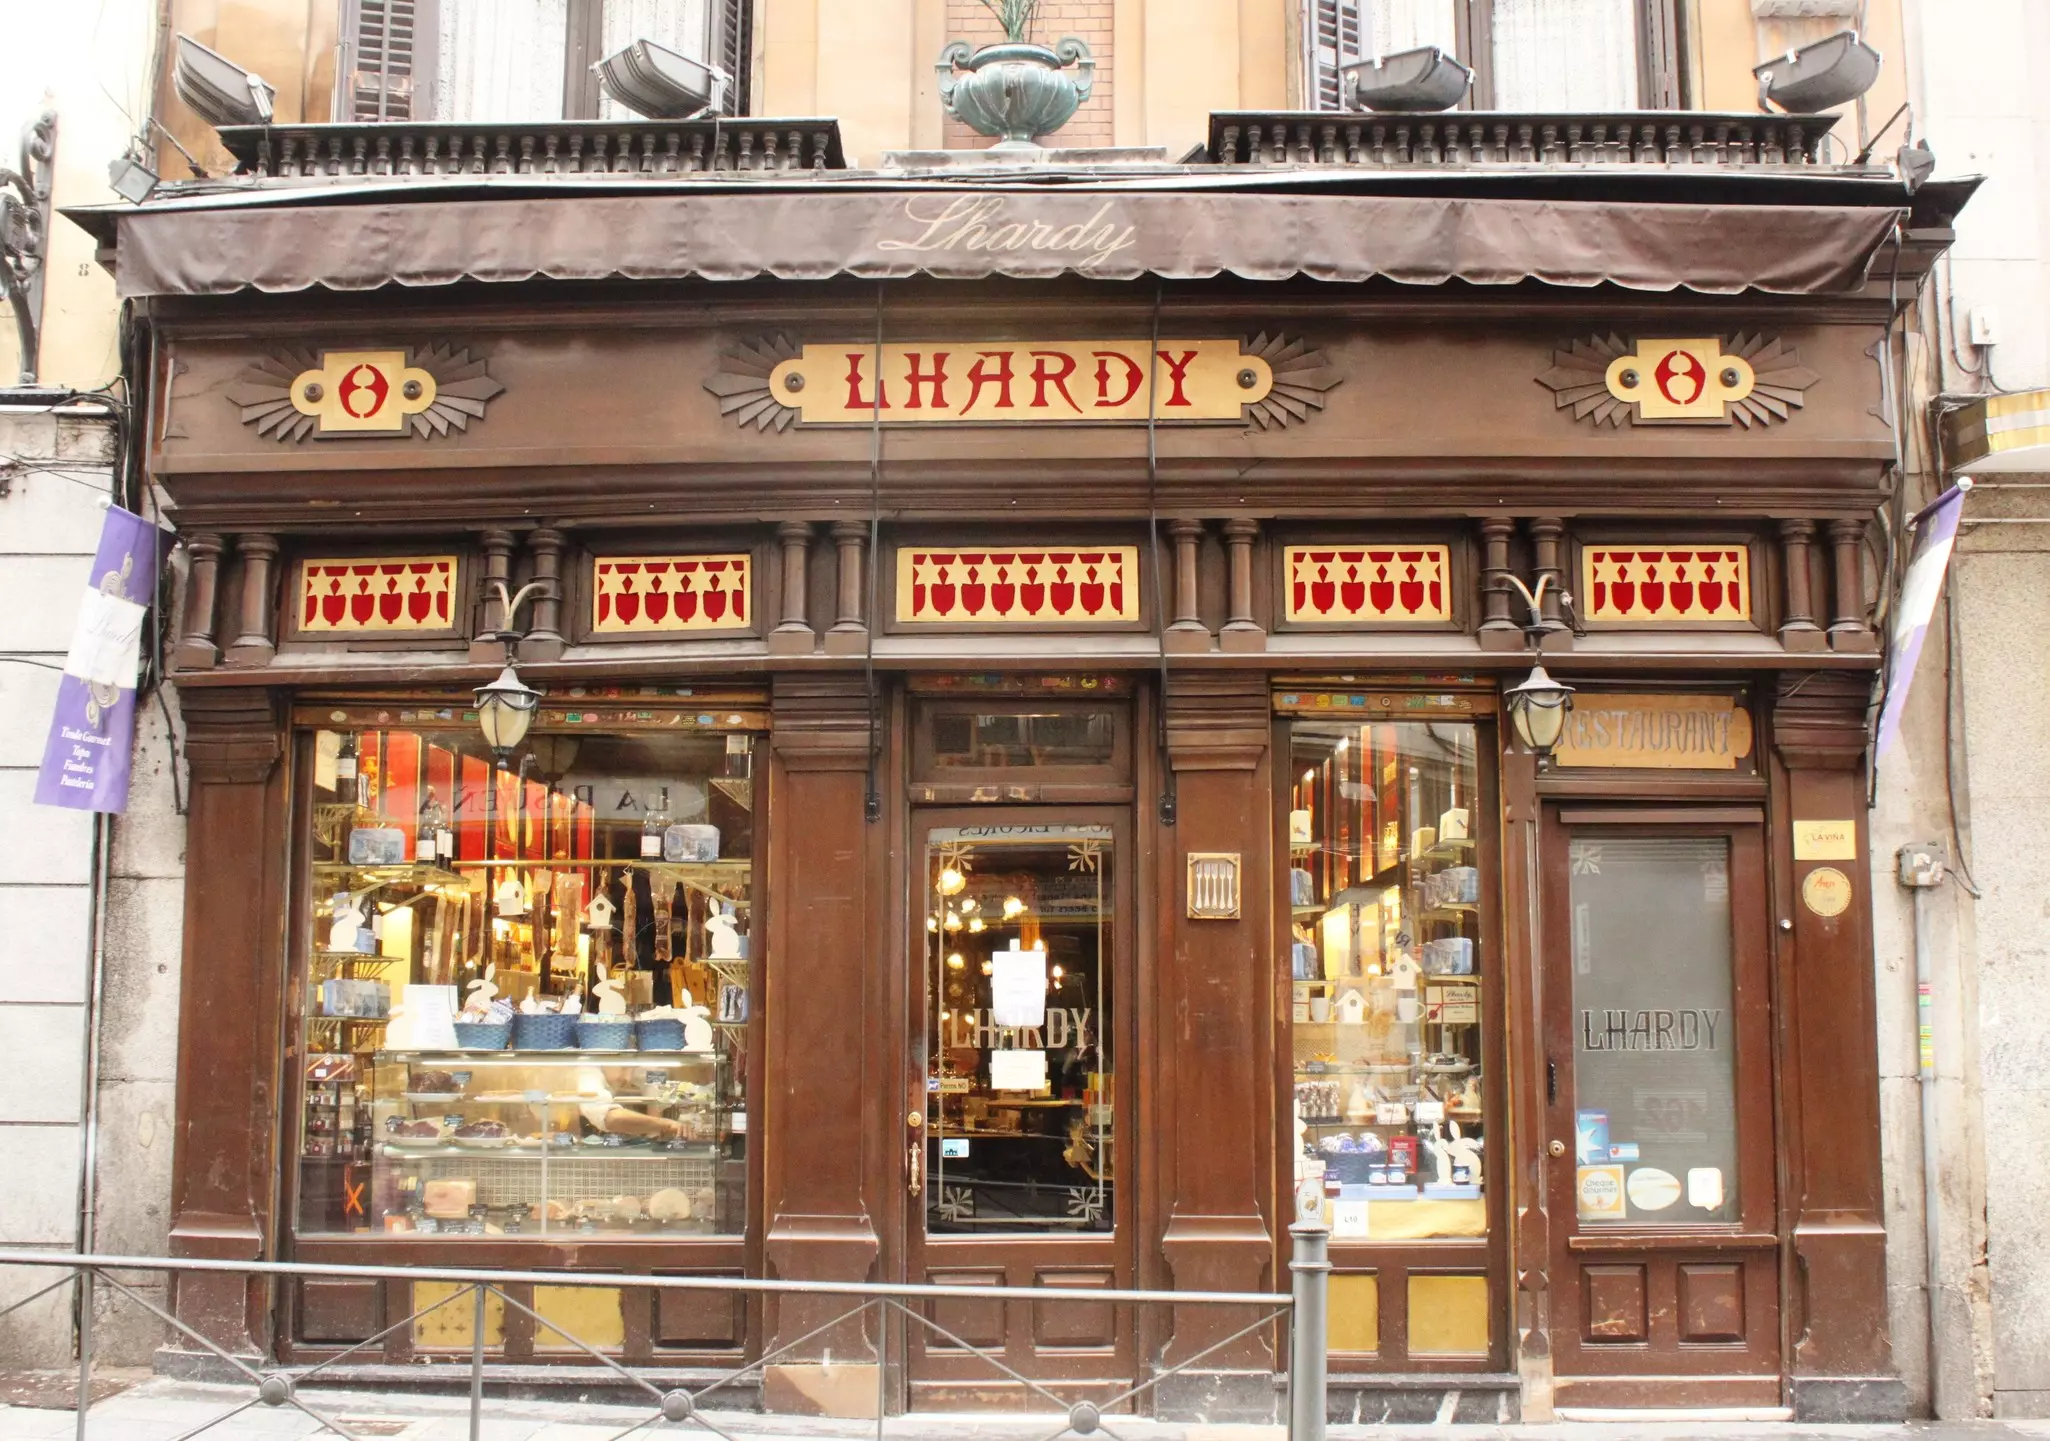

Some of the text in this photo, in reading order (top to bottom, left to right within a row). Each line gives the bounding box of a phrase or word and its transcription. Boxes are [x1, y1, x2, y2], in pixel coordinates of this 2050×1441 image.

[877, 194, 1135, 266] Lhardy
[78, 263, 90, 277] 8
[338, 363, 390, 419] 8
[844, 350, 1199, 416] LHARDY
[1654, 349, 1706, 405] 8
[1556, 709, 1734, 755] RESTAURANT
[949, 1007, 1091, 1049] LHARDY
[1581, 1009, 1725, 1052] LHARDY
